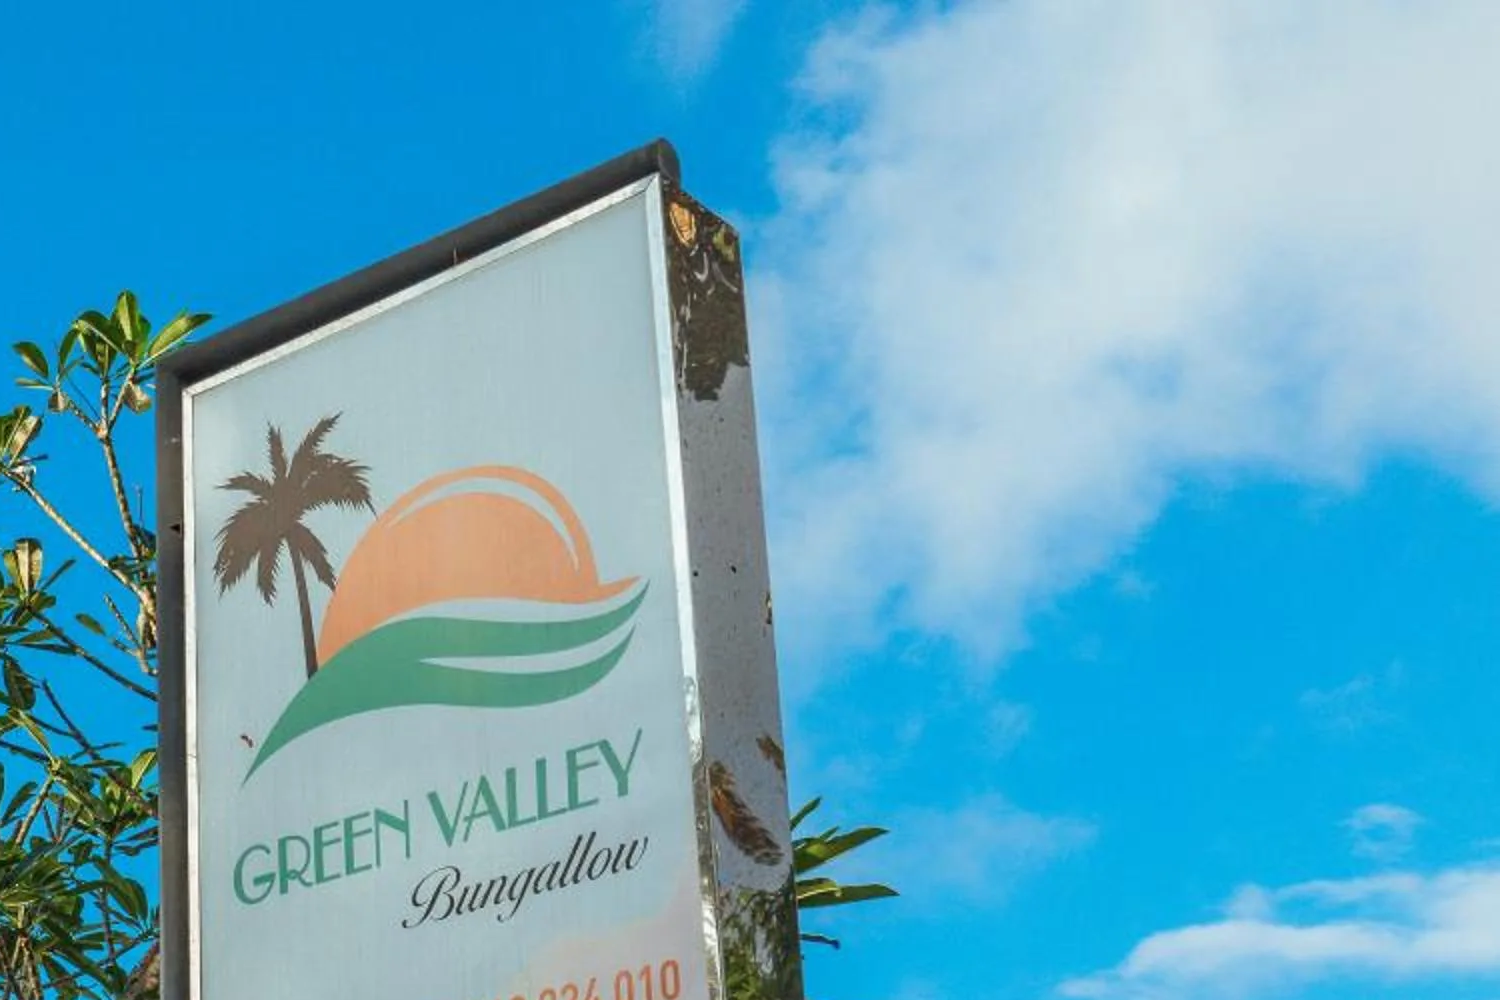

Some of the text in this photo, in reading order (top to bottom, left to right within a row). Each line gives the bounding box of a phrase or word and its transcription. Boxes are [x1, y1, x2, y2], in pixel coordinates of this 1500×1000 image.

[232, 728, 643, 905] GREEN VALLEY
[401, 831, 650, 929] Bungallow
